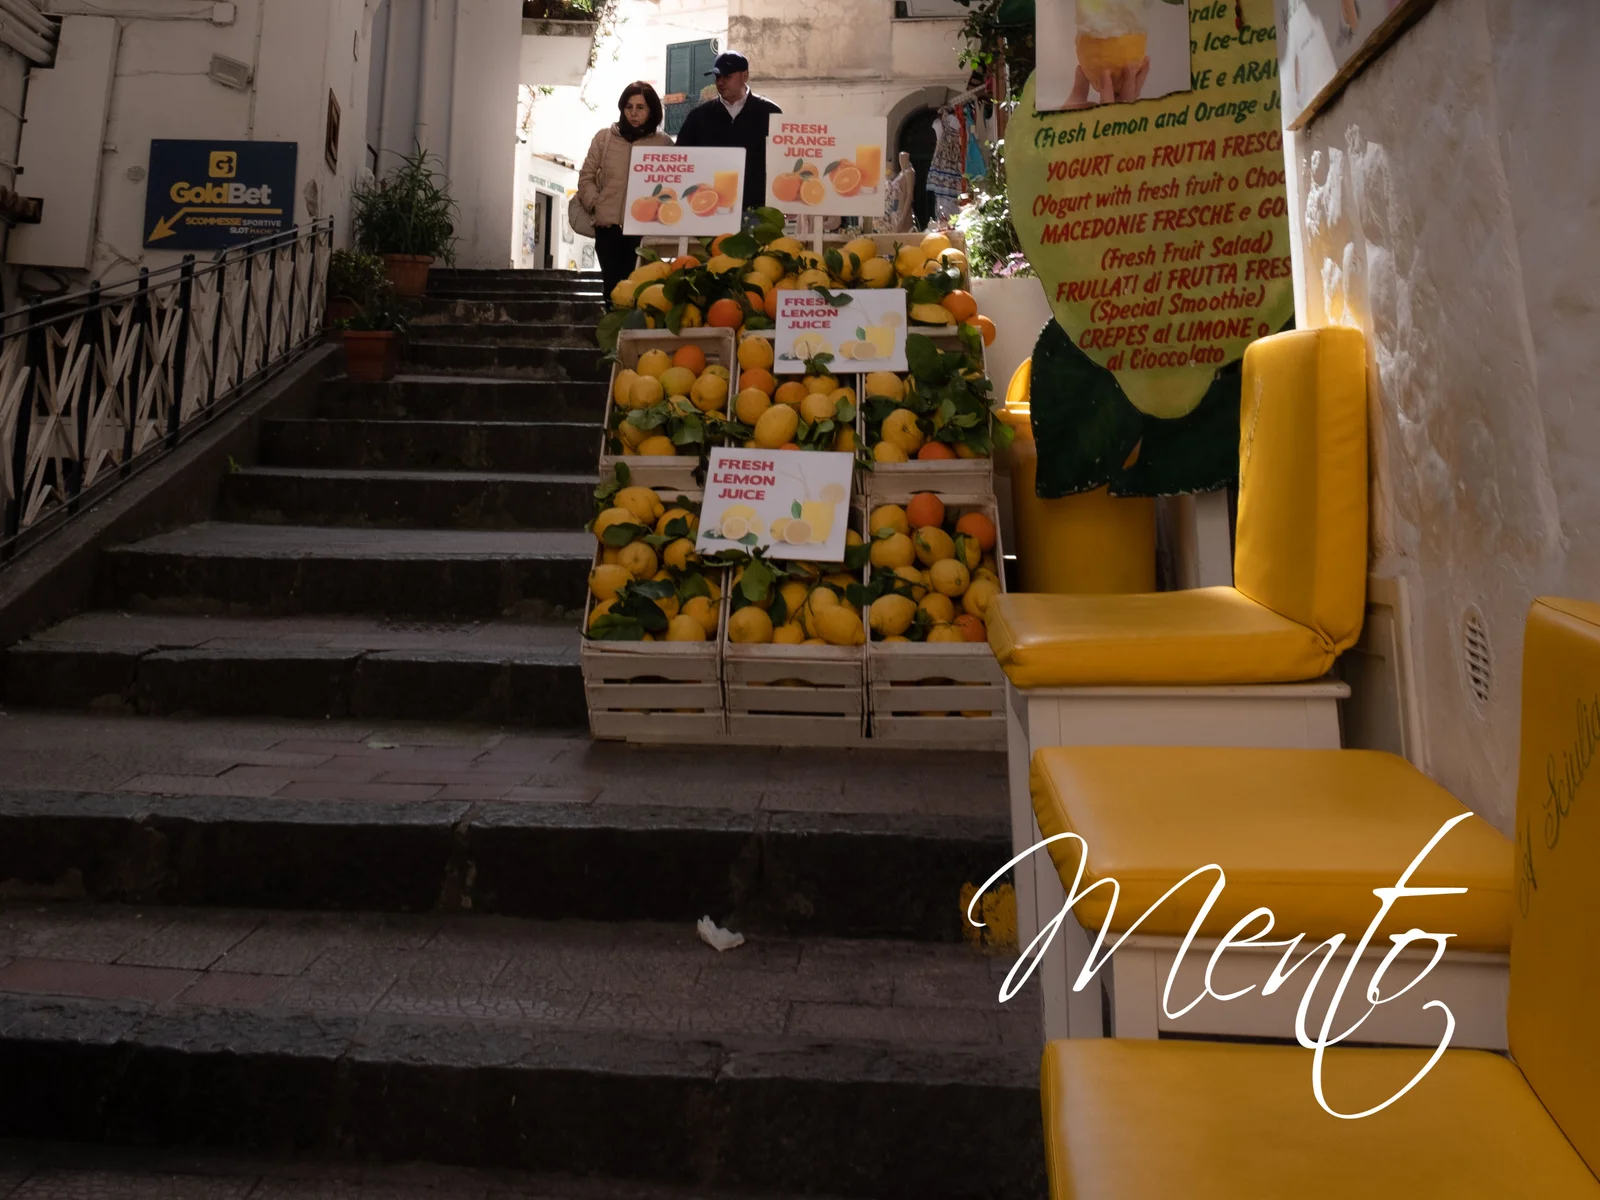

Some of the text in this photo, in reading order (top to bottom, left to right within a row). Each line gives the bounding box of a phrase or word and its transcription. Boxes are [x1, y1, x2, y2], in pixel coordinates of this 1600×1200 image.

[1216, 71, 1228, 87] e
[1093, 115, 1148, 139] Lemon
[1154, 108, 1188, 130] and
[1194, 97, 1257, 124] Orange
[781, 123, 828, 134] FRESH
[772, 134, 836, 146] ORANGE
[642, 153, 688, 163] FRESH
[784, 147, 823, 158] JUICE
[1047, 154, 1114, 182] YOGURT
[1116, 155, 1146, 173] con
[1151, 138, 1217, 168] FRUTTA
[633, 164, 695, 173] ORANGE
[644, 174, 682, 183] JUICE
[169, 181, 272, 205] GoldBet
[1032, 191, 1093, 219] (Yogurt
[1096, 185, 1132, 208] with
[1137, 177, 1180, 201] fresh
[1186, 171, 1225, 197] fruit
[1228, 175, 1239, 191] o
[185, 216, 282, 228] SCOMMESSE SPORTIVE
[1040, 212, 1148, 246] MACEDONIE
[1152, 202, 1236, 233] FRESCHE
[1239, 207, 1252, 221] e
[230, 227, 248, 235] SLOT
[1101, 230, 1273, 271] (Fresh Fruit Salad)
[1056, 274, 1138, 302] FRULLATI
[1144, 270, 1161, 294] di
[1167, 262, 1238, 291] FRUTTA
[784, 298, 830, 306] FRES
[1090, 284, 1266, 324] (Special Smoothie)
[781, 308, 838, 317] LEMON
[788, 320, 831, 329] JUICE
[1079, 317, 1270, 350] CREPES al LIMONE o
[1106, 345, 1225, 371] al Cioccolato
[718, 458, 774, 471] FRESH
[712, 473, 776, 486] LEMON
[718, 488, 766, 500] JUICE
